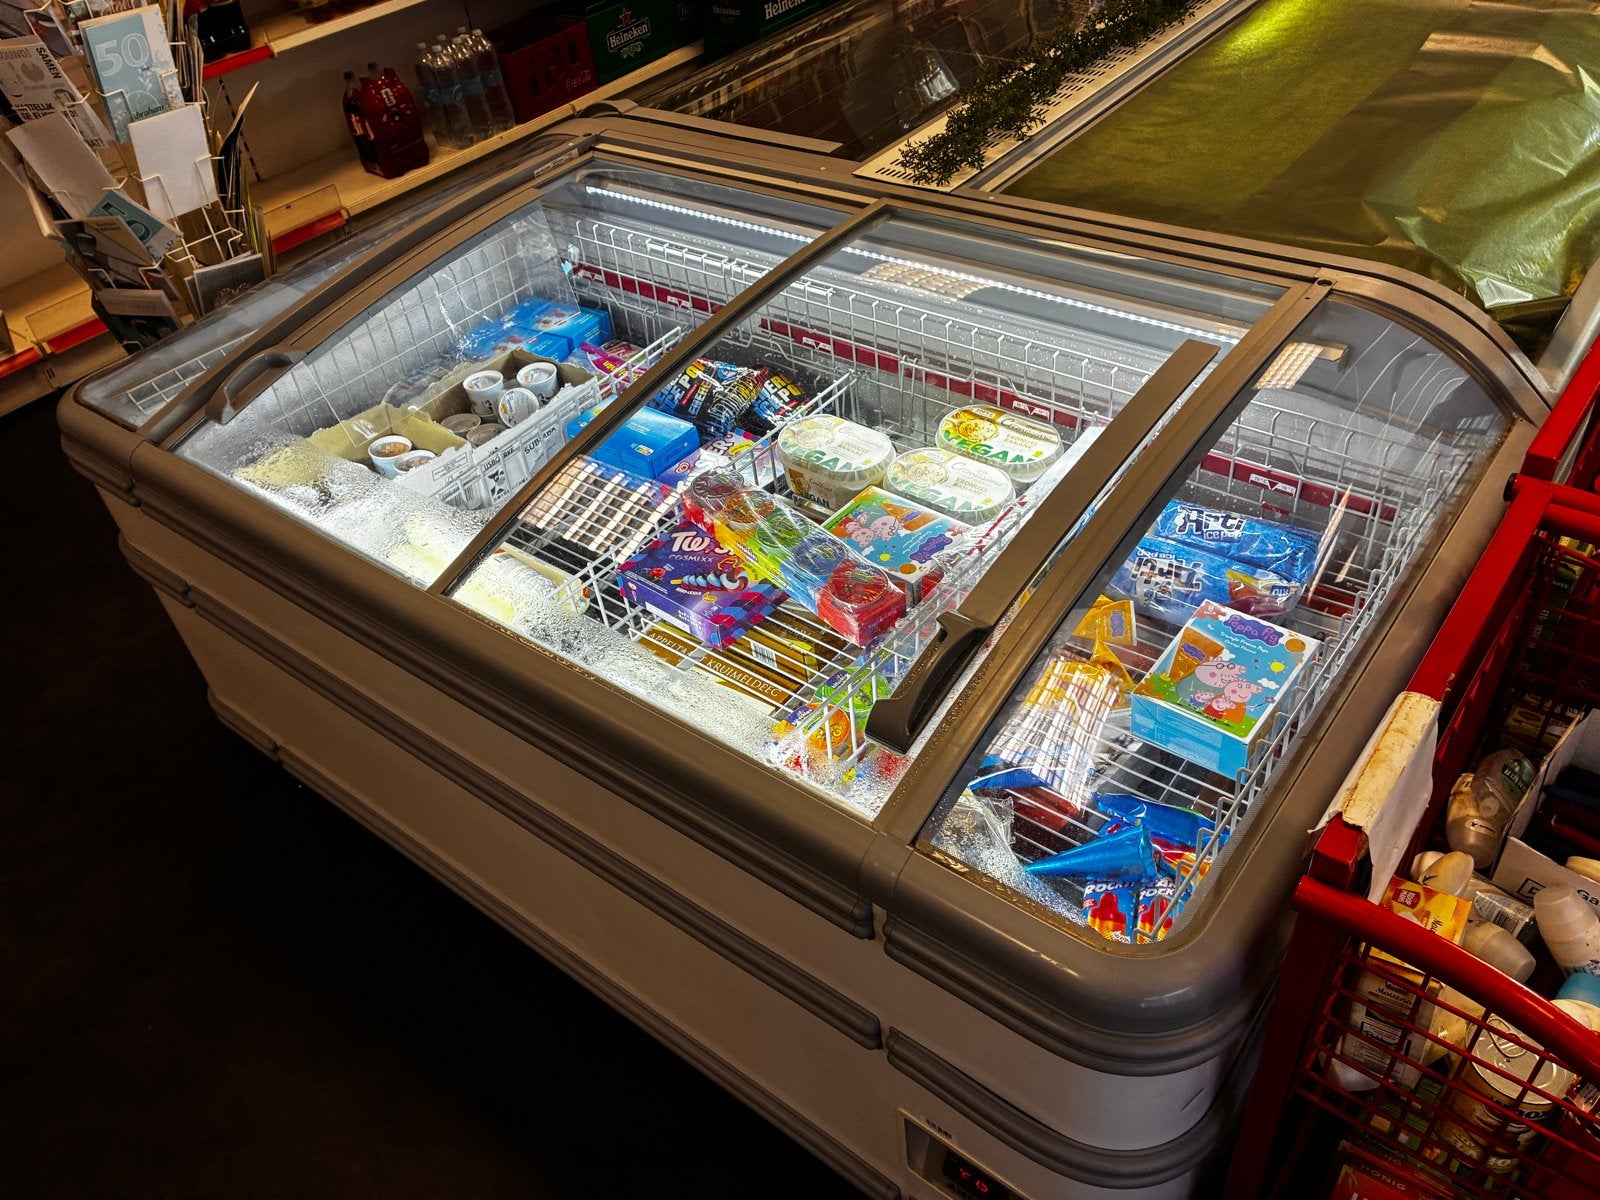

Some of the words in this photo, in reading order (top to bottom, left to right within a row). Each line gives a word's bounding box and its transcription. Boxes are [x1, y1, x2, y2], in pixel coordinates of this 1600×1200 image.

[609, 24, 649, 48] Heineken
[36, 47, 62, 79] SAMEN
[95, 33, 150, 78] 50
[942, 430, 1035, 463] VEGAN
[1003, 438, 1033, 450] BANANE
[952, 483, 983, 496] BANANE
[1203, 530, 1220, 540] ice
[1221, 530, 1243, 541] pop
[669, 554, 714, 563] COSMIXX
[1228, 615, 1259, 637] Peppa
[1261, 627, 1280, 643] Pig
[1220, 631, 1241, 643] Triangle
[1240, 639, 1257, 649] Freeze
[1257, 645, 1269, 654] Pops
[706, 656, 782, 698] KRUIMELDEEG
[1361, 1164, 1406, 1190] HONIG
